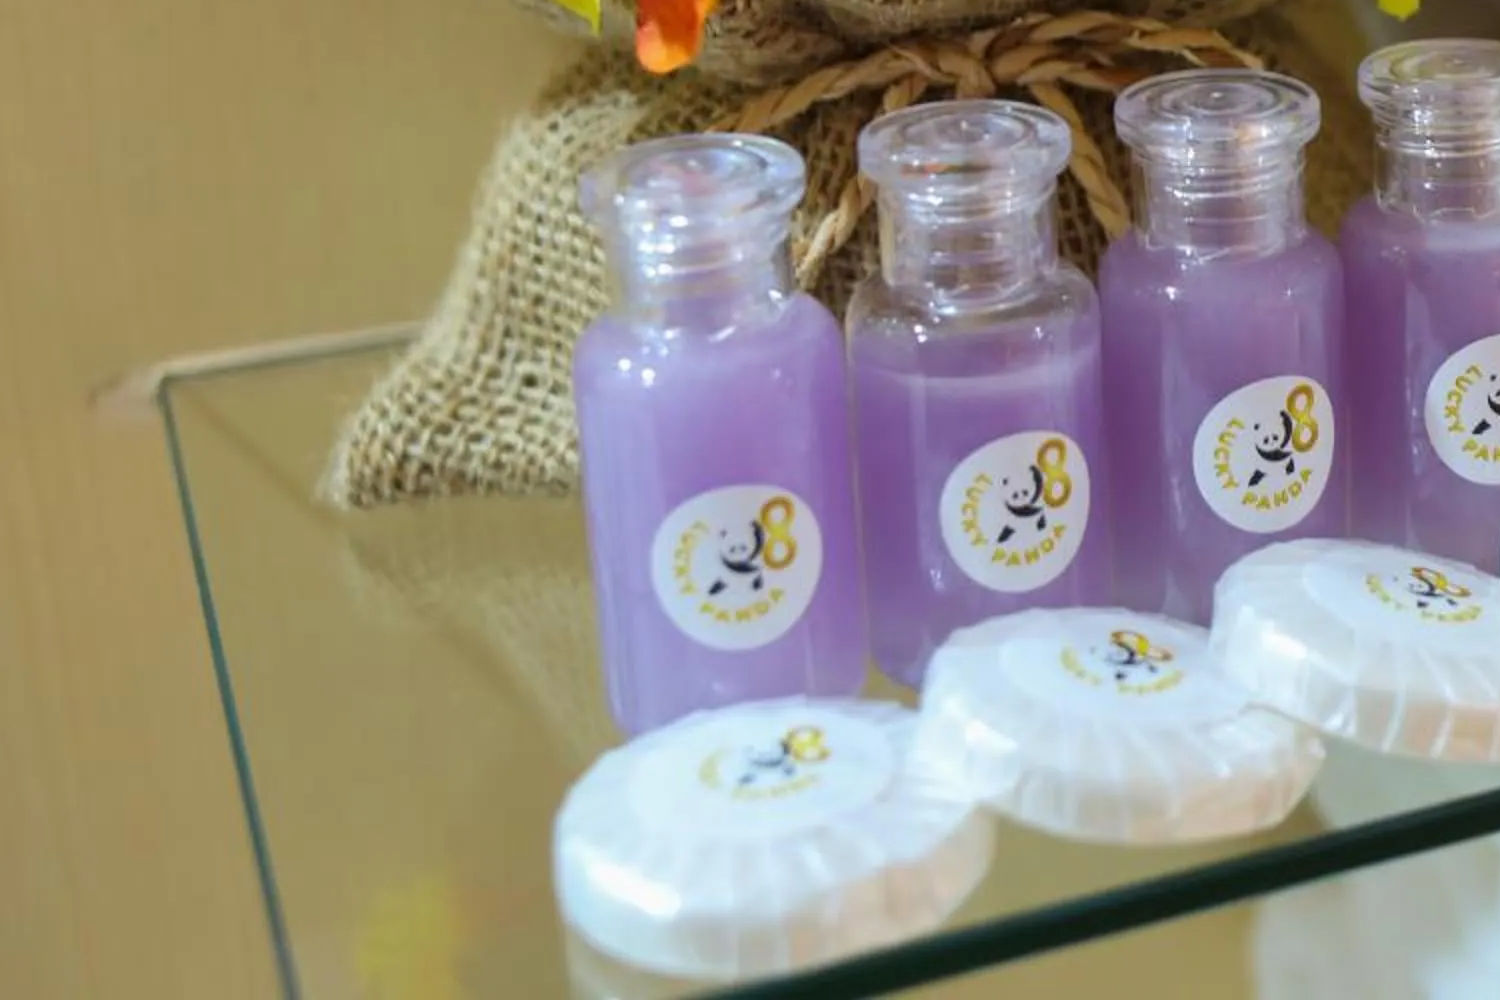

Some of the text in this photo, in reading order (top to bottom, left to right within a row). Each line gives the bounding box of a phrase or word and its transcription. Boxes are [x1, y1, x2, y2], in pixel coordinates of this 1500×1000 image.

[1444, 364, 1482, 433] LUCKY
[1214, 417, 1313, 511] LUCKY PANDA
[992, 524, 1067, 568] PANDA
